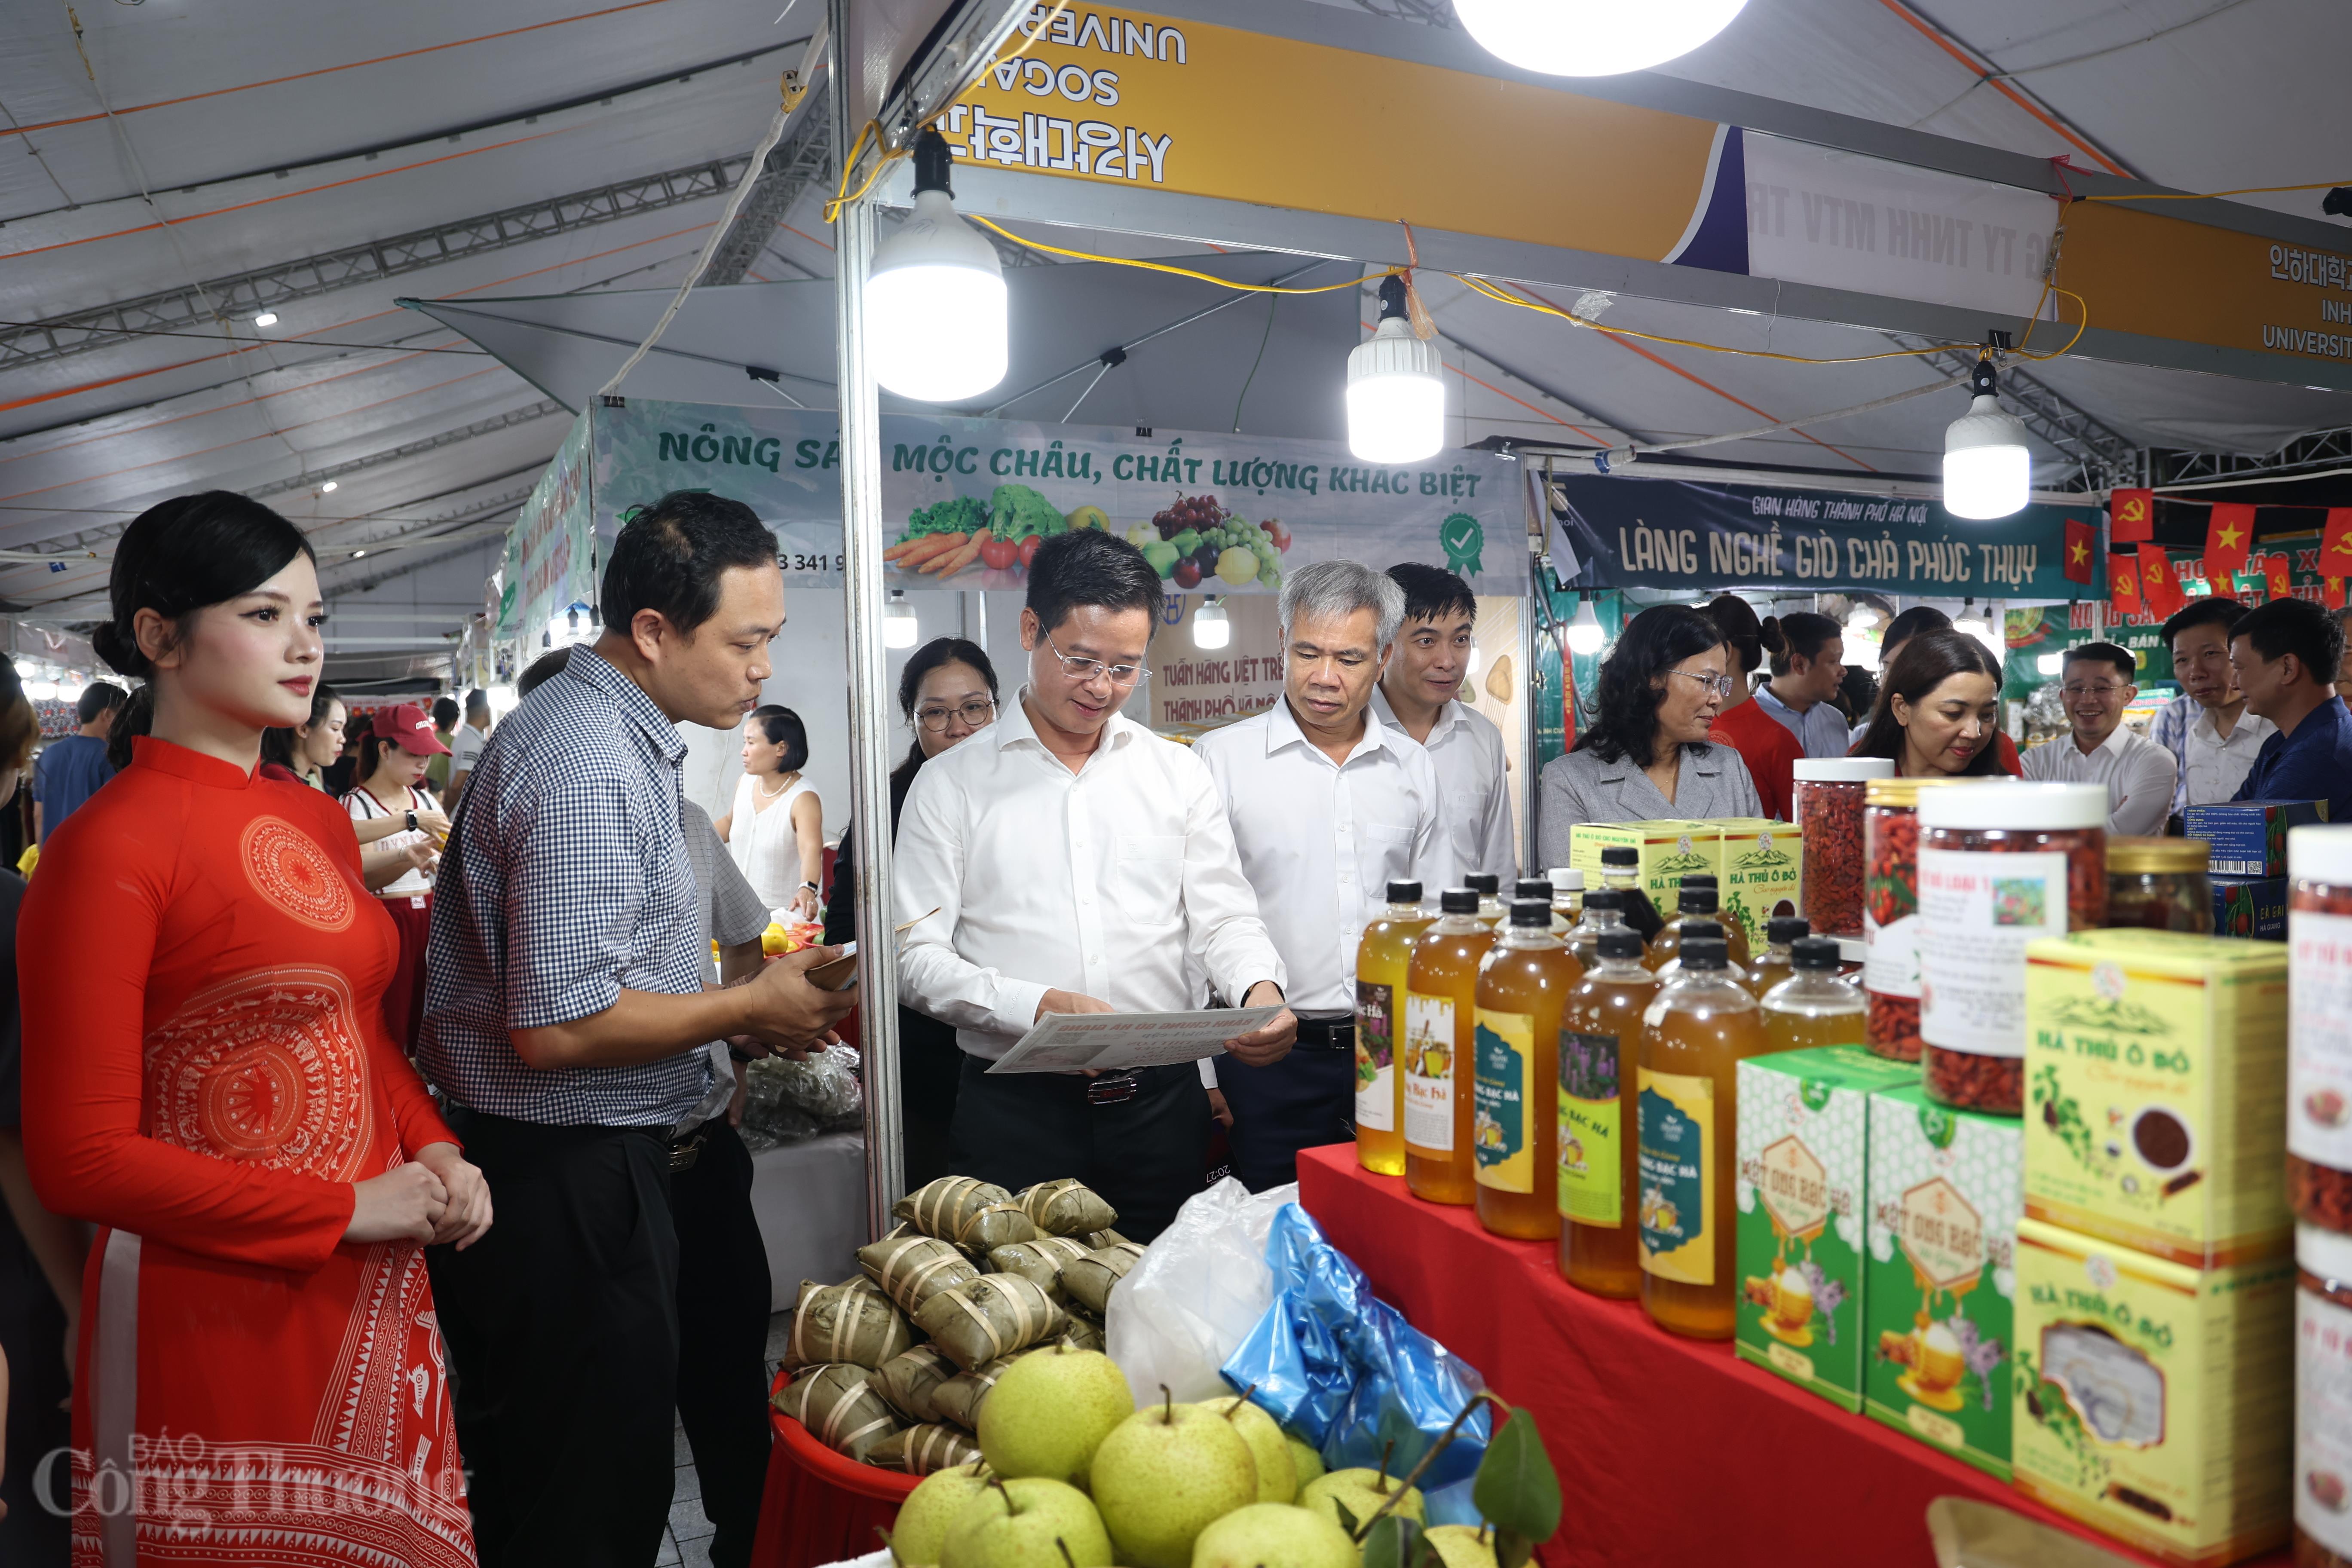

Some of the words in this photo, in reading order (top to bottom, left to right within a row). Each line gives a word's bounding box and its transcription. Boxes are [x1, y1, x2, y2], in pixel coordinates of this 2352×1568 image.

[1013, 3, 1186, 64] UNIVER
[2322, 299, 2352, 325] INH
[2263, 324, 2352, 359] UNIVERSIT
[658, 423, 781, 473] NÔNG
[892, 434, 977, 483] MỘC
[989, 440, 1102, 485] CHÂU,
[1113, 438, 1203, 484] CHẤT
[1213, 456, 1318, 496] LƯỢNG
[1329, 464, 1409, 496] KHÁC
[1419, 464, 1482, 504] BIỆT
[1752, 496, 1782, 516] GIAN
[1785, 495, 1821, 518] HÀNG
[1823, 499, 1864, 521] THÀNH
[1864, 499, 1891, 522] PHỐ
[1907, 503, 1929, 527] NỘI
[794, 554, 827, 571] 341
[1619, 519, 1698, 574] LÀNG
[1709, 521, 1784, 576] NGHỀ
[1795, 529, 1838, 579] GIÒ
[1847, 530, 1899, 579] CHẢ
[1907, 534, 1972, 583] PHÚC
[1262, 652, 1284, 681] TRÊ
[1651, 876, 1666, 889] HÀ
[1668, 878, 1682, 888] TH
[1730, 871, 1745, 884] HÀ
[1748, 868, 1769, 883] THỦ
[1771, 870, 1780, 882] Ô
[2260, 924, 2266, 932] HÀ
[2267, 922, 2281, 931] GIANG
[2037, 1028, 2066, 1050] HÀ
[1206, 1164, 1231, 1183] 20:27
